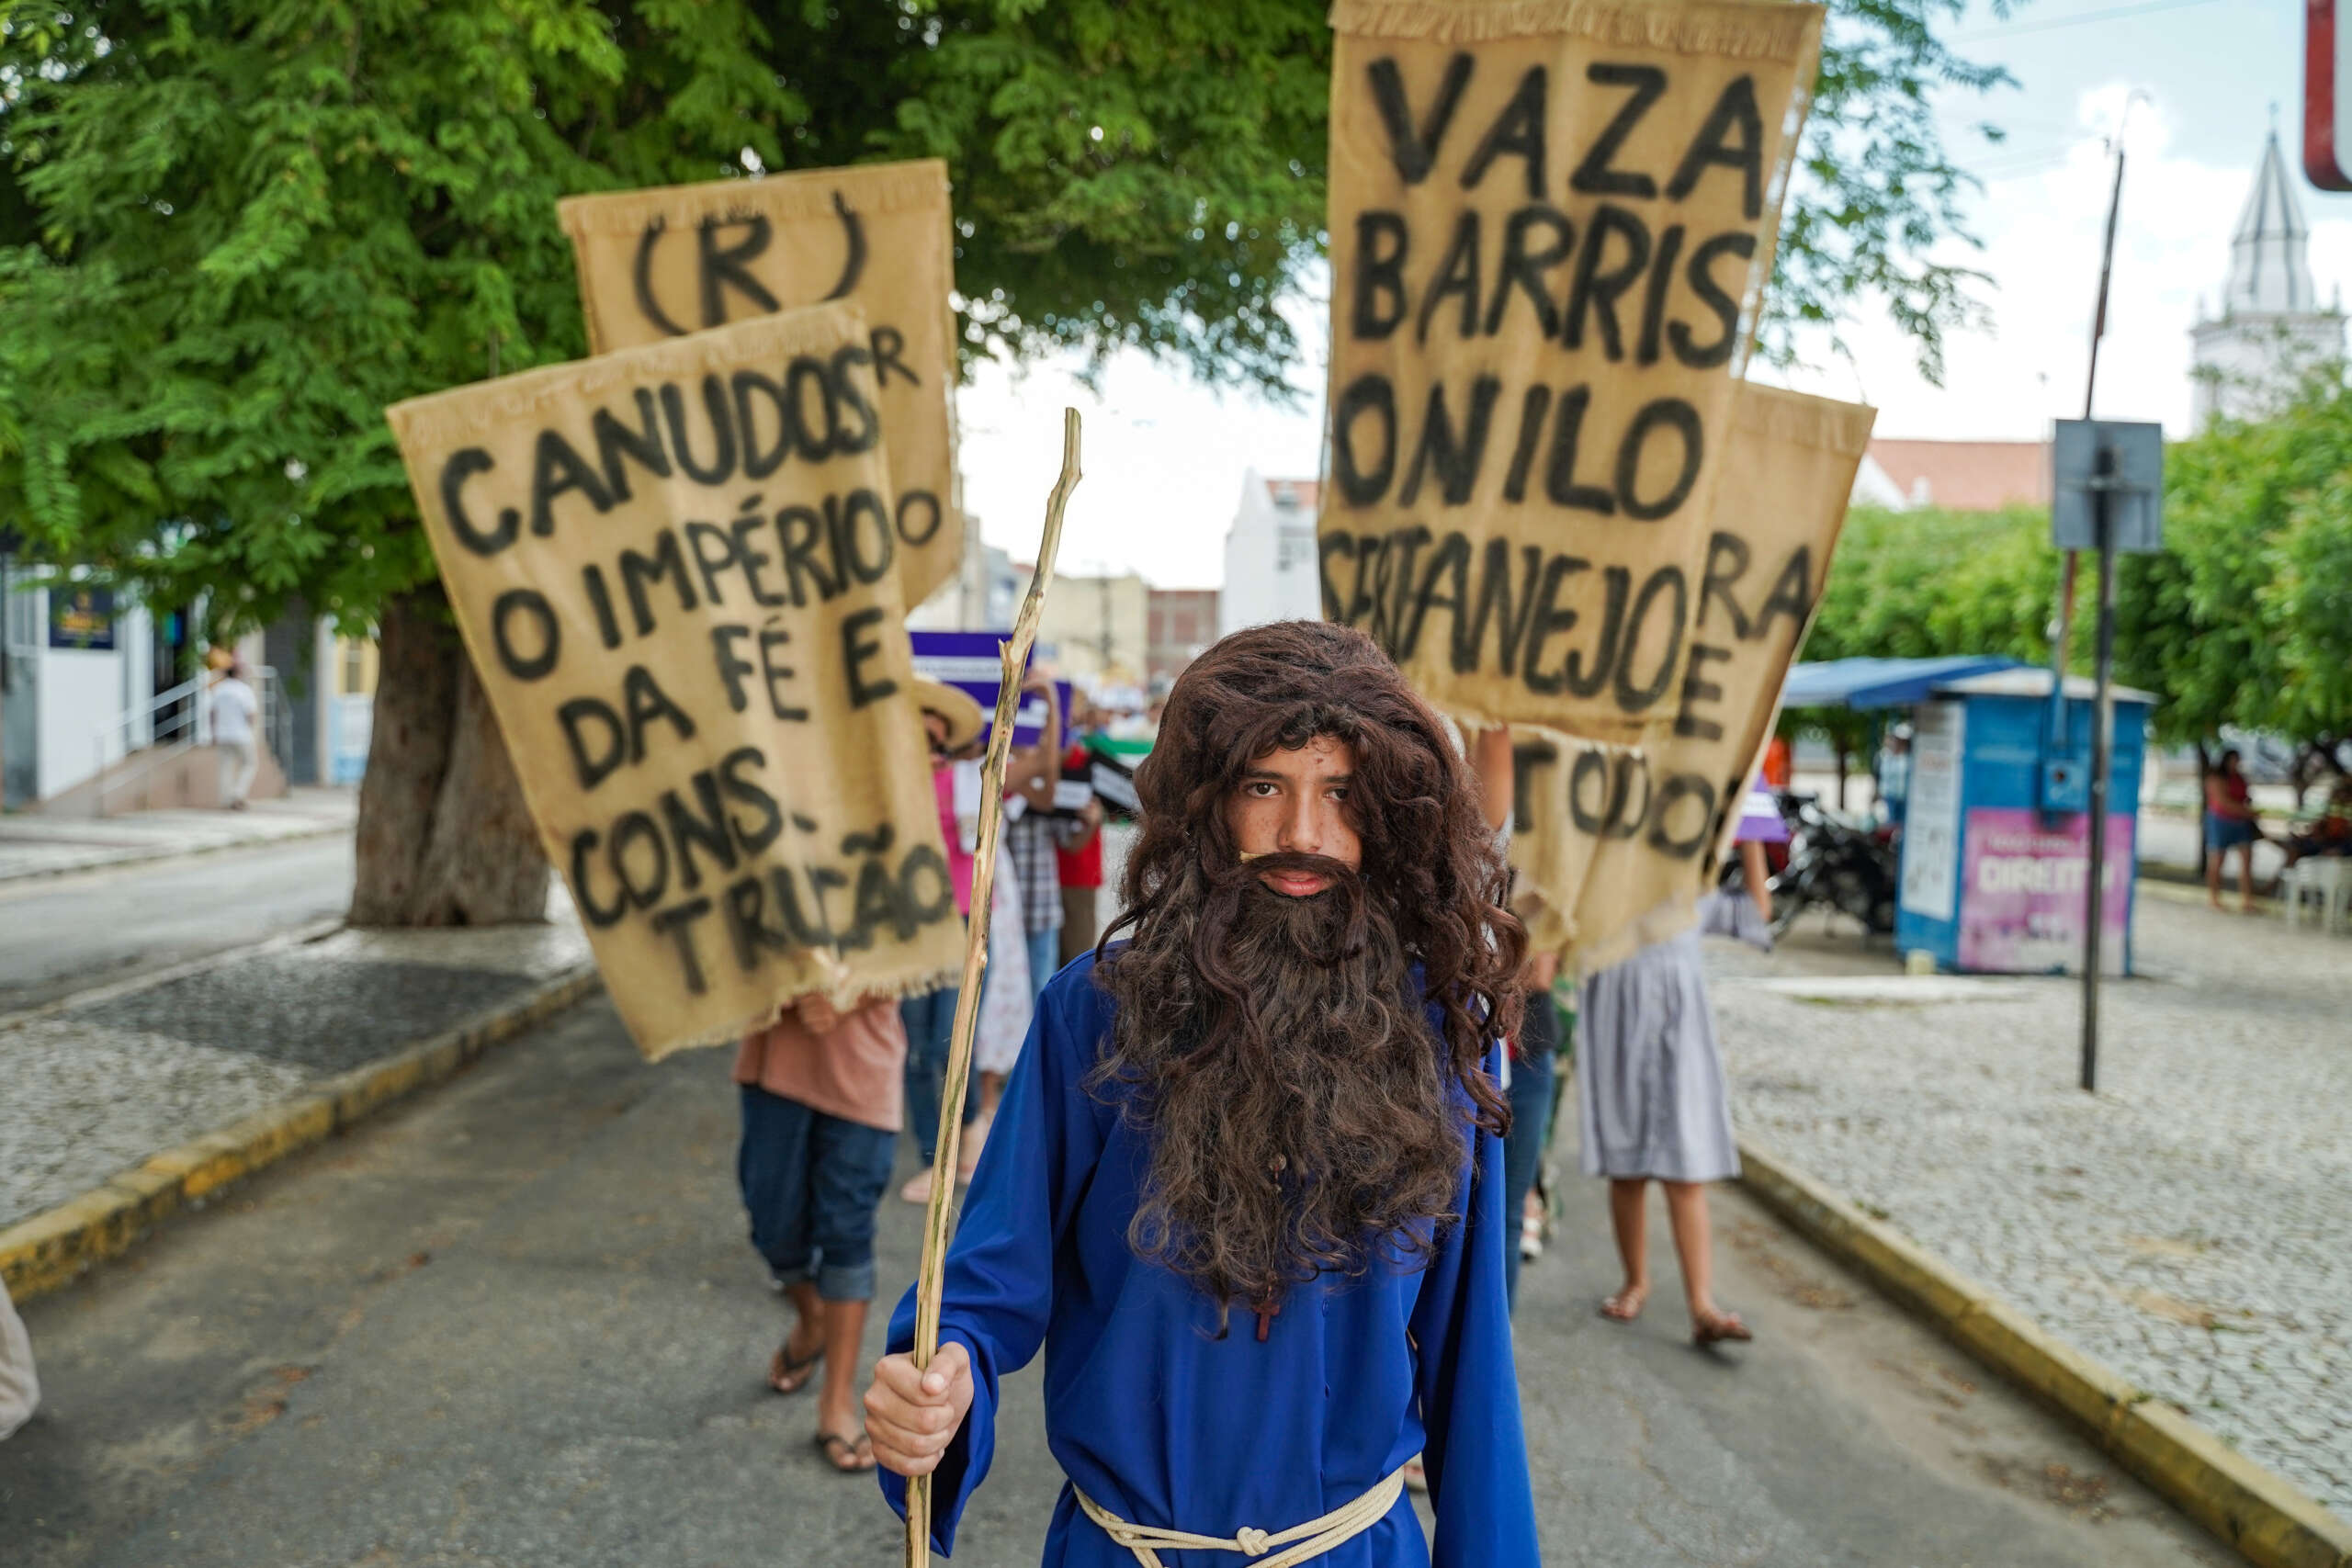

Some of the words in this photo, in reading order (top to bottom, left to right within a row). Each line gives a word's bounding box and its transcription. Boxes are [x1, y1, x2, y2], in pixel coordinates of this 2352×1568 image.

[1367, 51, 1763, 220] VAZA
[1351, 204, 1758, 367] BARRIS
[440, 345, 881, 558] CANUDOS
[492, 588, 561, 682] O
[582, 491, 896, 651] IMPÉRIO
[557, 665, 696, 792] DA
[711, 615, 809, 722] FÉ
[842, 606, 899, 710] E
